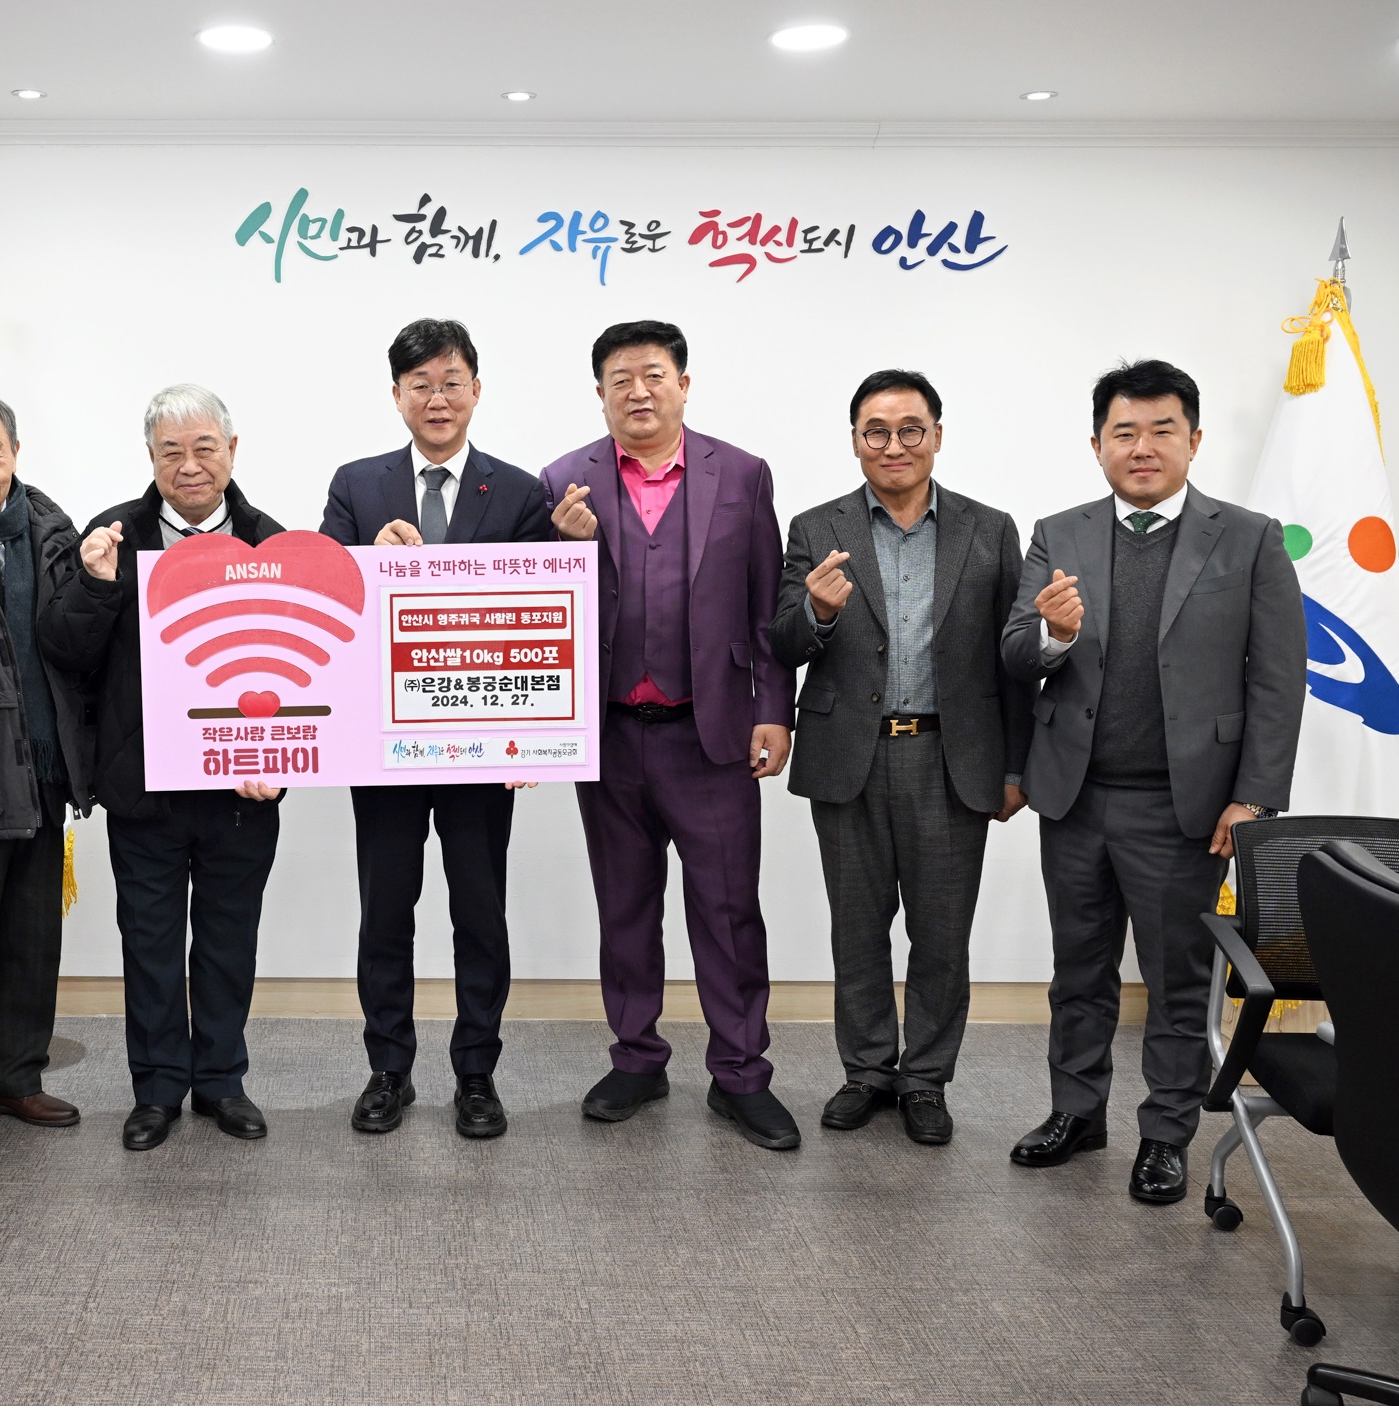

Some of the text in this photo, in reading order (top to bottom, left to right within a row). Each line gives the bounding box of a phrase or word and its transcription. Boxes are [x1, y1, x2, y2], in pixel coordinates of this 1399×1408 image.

[234, 187, 1009, 286] 시민과 함께, 자유로운 혁신도시 안산
[225, 563, 283, 581] ANSAN
[379, 557, 586, 578] 나눔을 전파하는 따뜻한 에너지
[401, 611, 563, 627] 안산시 영주귀국 사할린 동포지원
[411, 646, 560, 667] 안산쌀10kg 500포
[431, 693, 535, 708] 2024. 12. 27.
[202, 724, 318, 743] 작은사랑 큰보람
[203, 746, 319, 776] 하트파이
